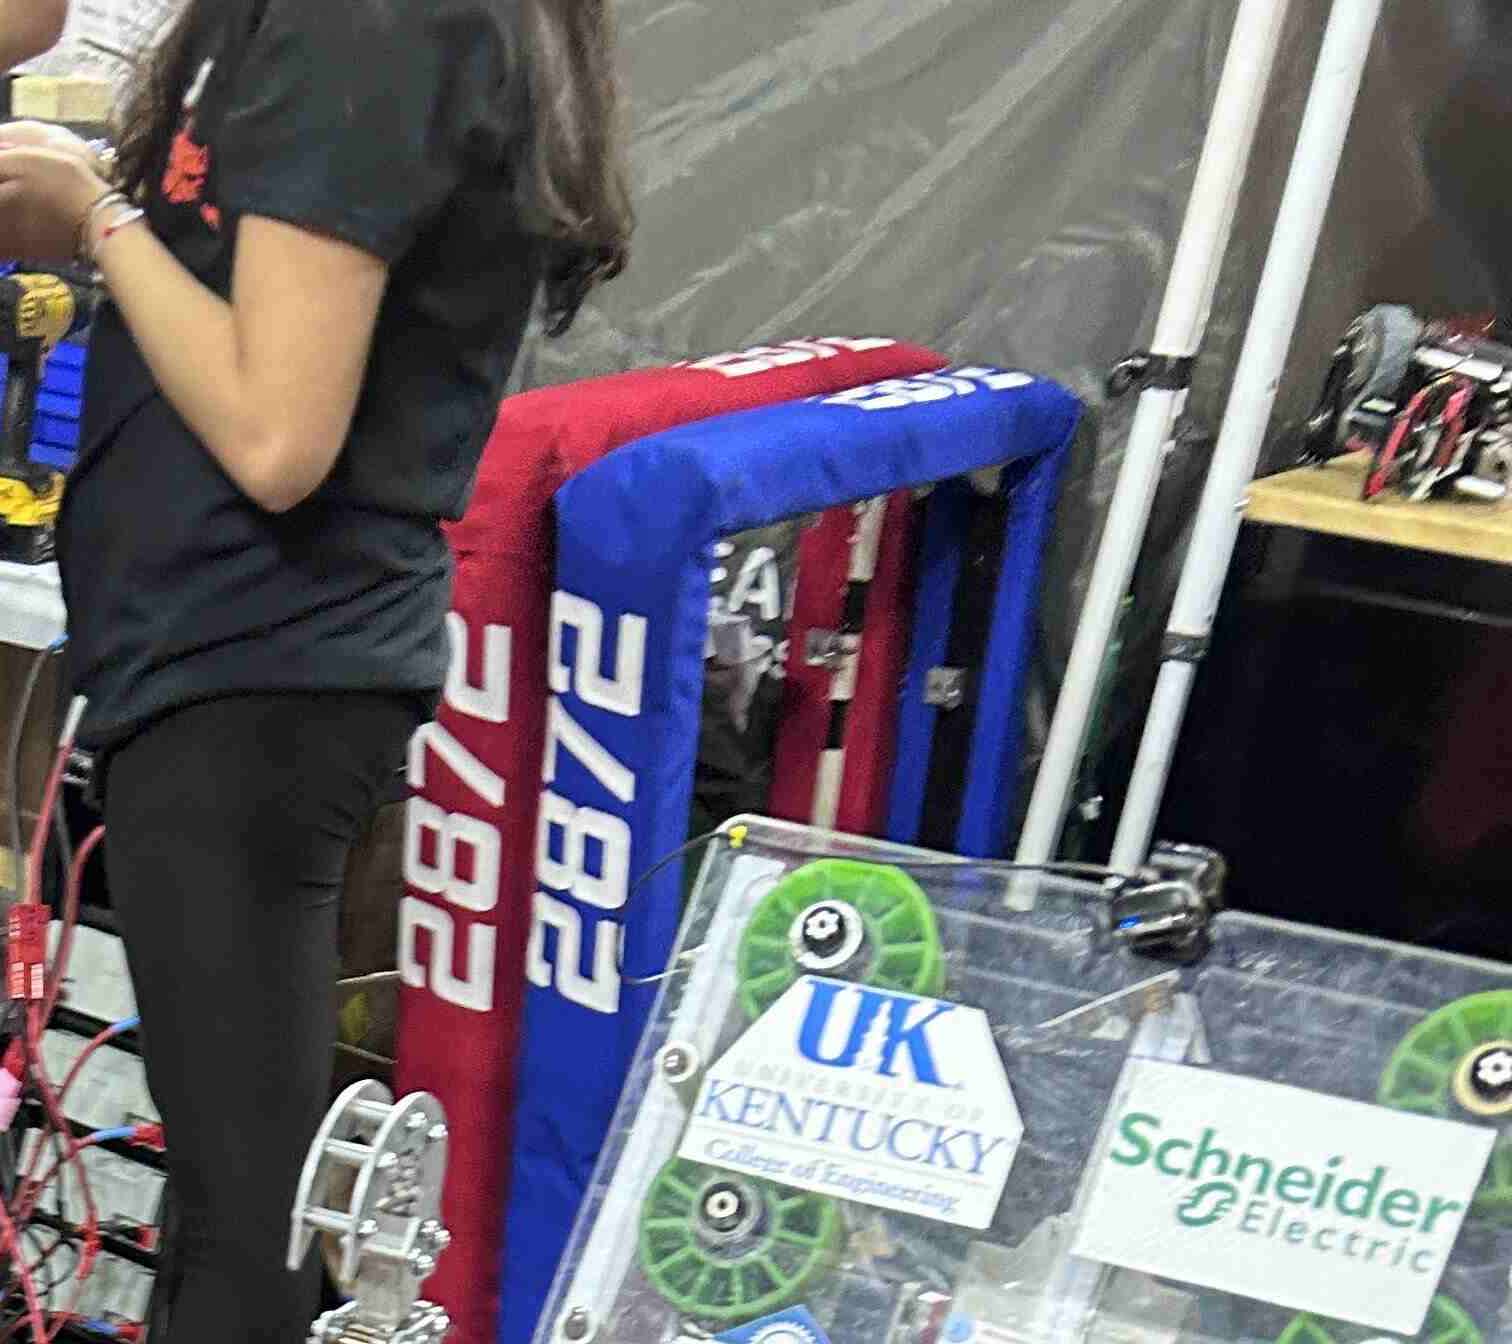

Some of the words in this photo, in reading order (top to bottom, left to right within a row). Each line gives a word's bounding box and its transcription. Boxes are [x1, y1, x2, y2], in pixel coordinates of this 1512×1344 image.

[398, 610, 512, 1013] 2872
[526, 590, 648, 1015] 2872
[797, 979, 964, 1090] UK
[696, 1078, 1006, 1175] KENTUCKY
[703, 1138, 789, 1174] College
[791, 1158, 820, 1179] of
[819, 1159, 963, 1215] Engineering
[1109, 1112, 1465, 1234] Schneider
[1237, 1199, 1440, 1275] Electric
